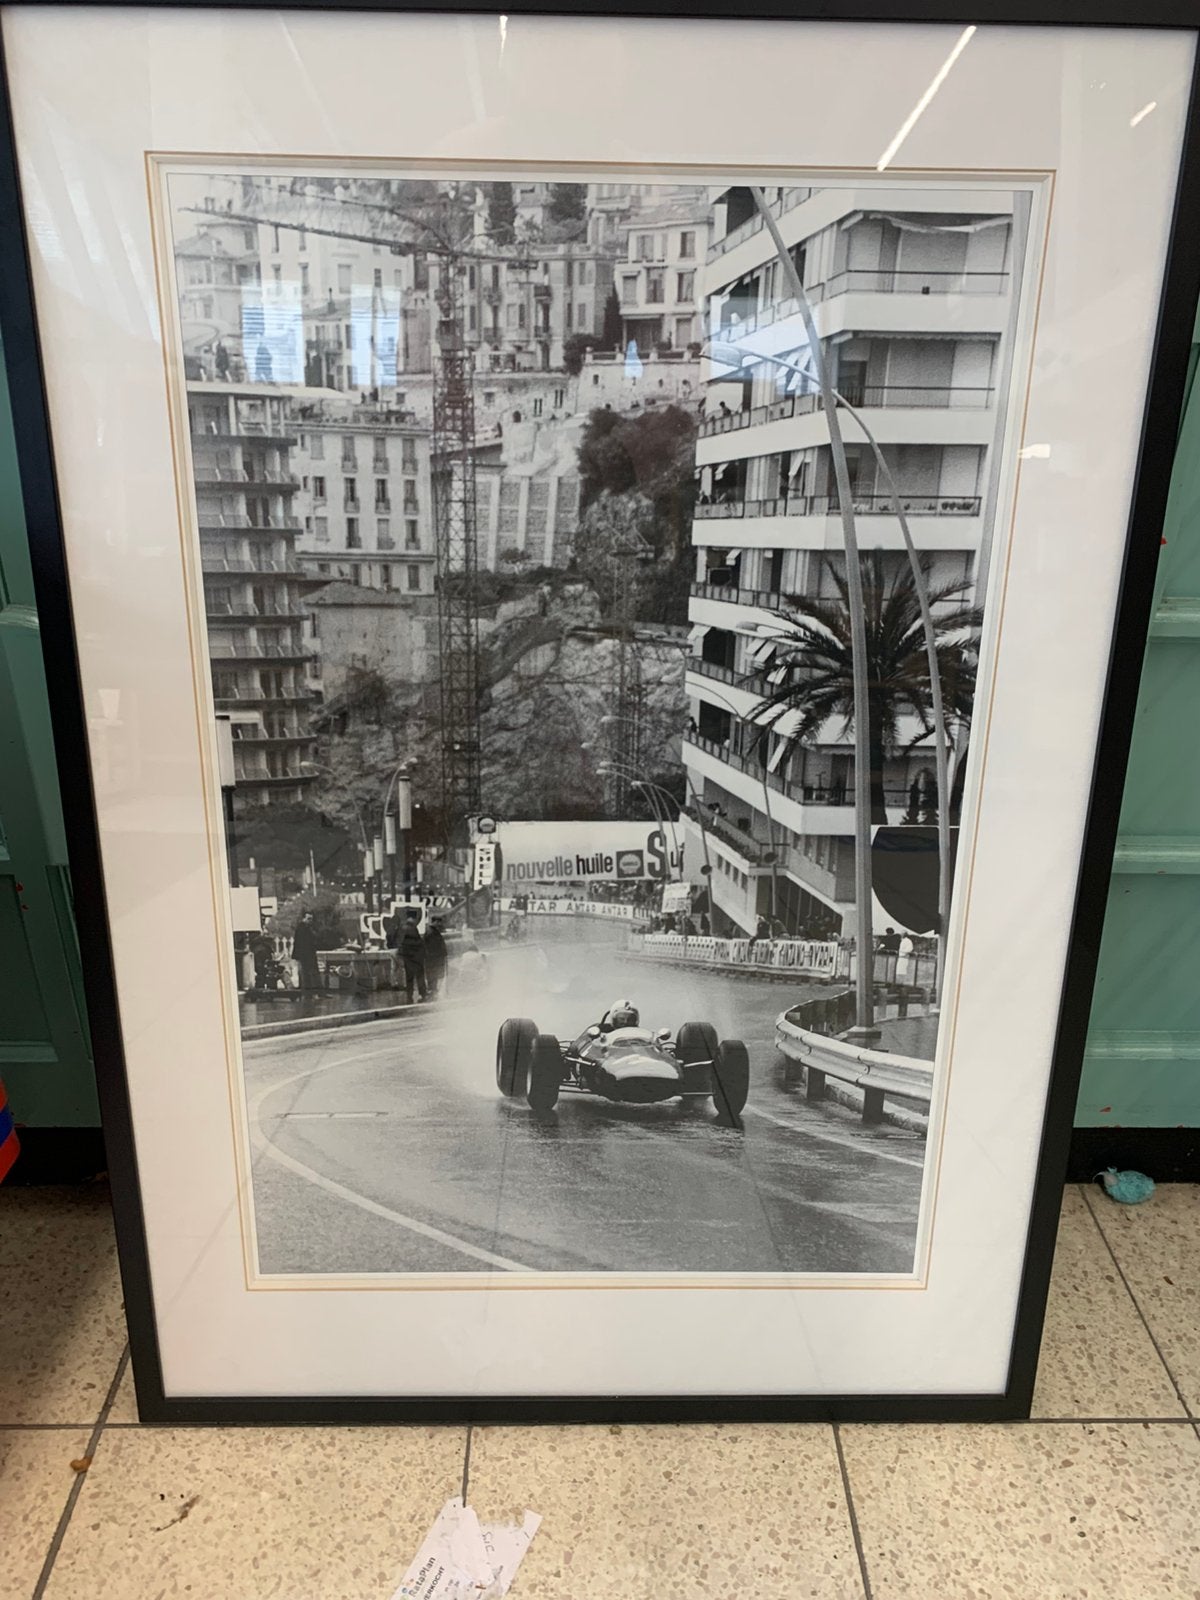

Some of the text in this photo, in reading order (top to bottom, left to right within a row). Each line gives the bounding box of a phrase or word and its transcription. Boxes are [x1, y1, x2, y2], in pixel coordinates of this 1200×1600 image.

[506, 856, 573, 881] nouvelle
[576, 852, 613, 875] huile
[508, 901, 557, 913] ATAR
[408, 1556, 436, 1597] RataPlan
